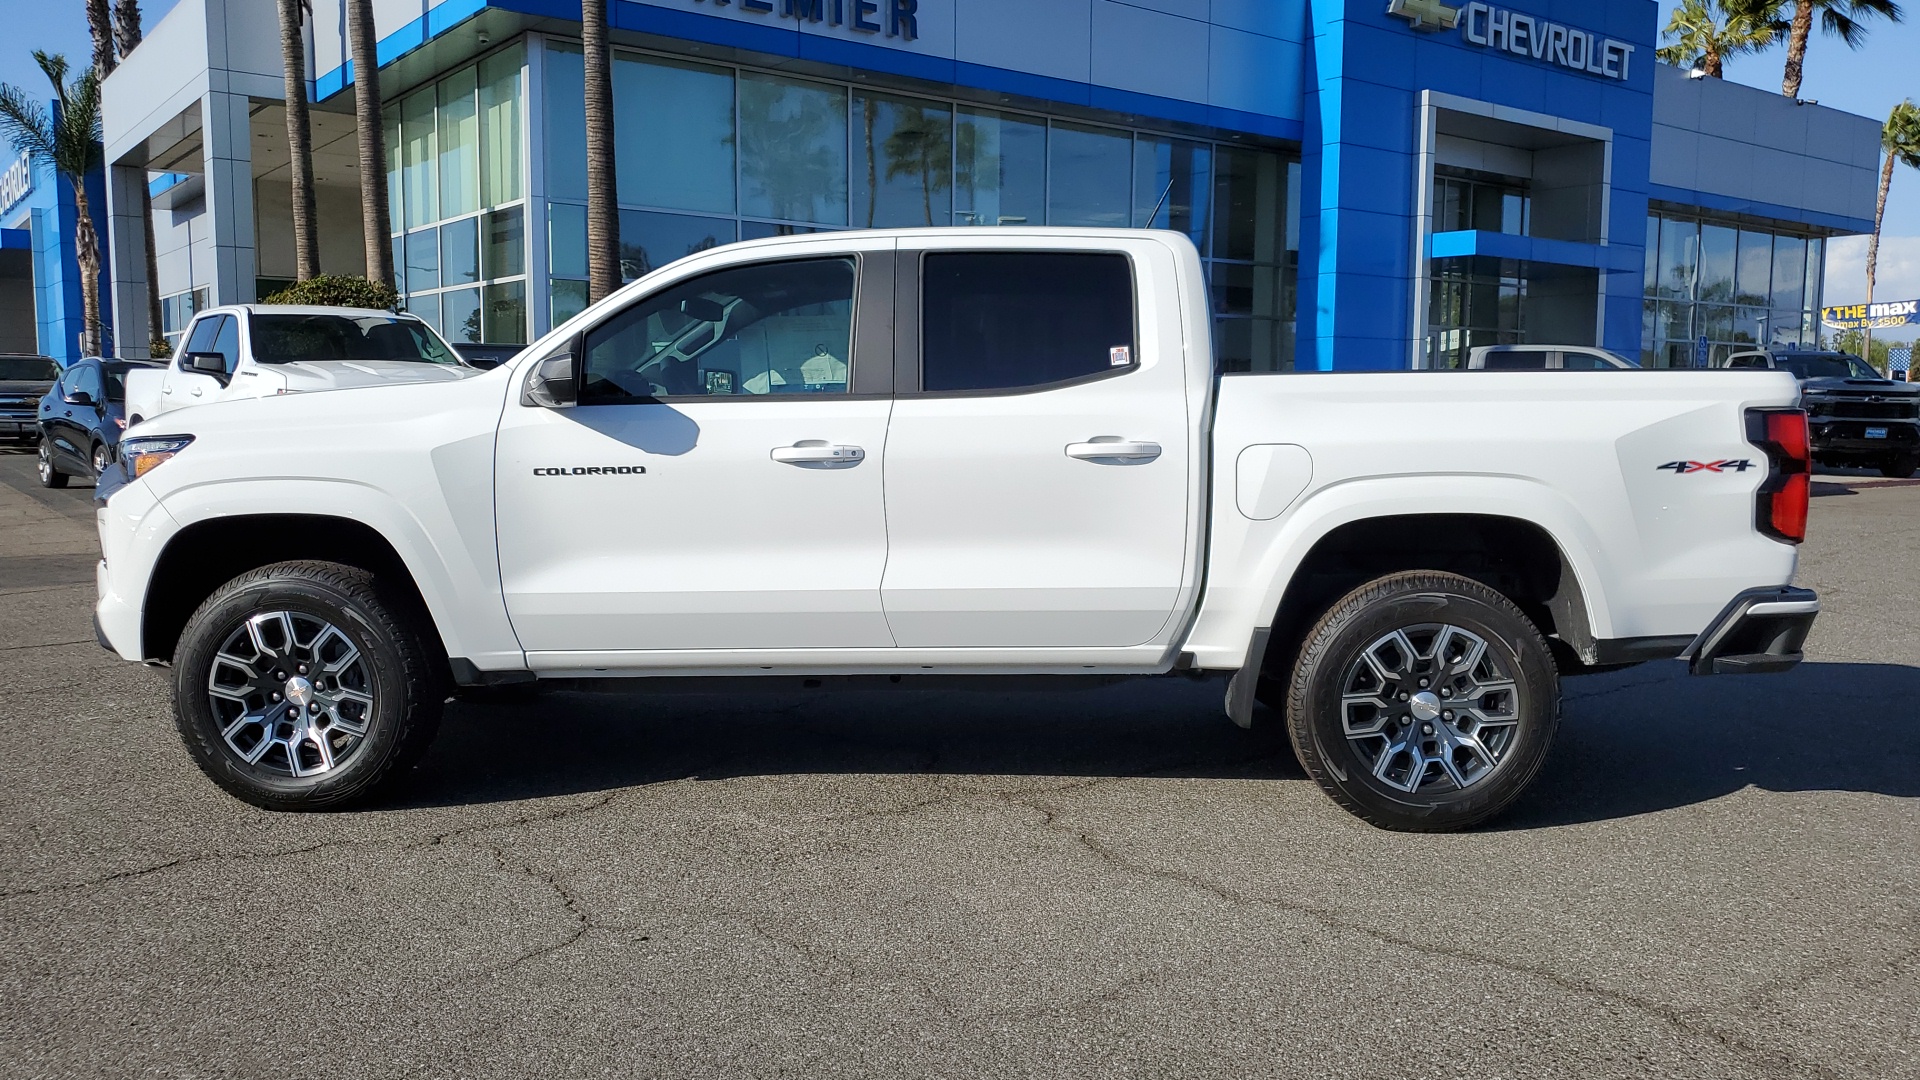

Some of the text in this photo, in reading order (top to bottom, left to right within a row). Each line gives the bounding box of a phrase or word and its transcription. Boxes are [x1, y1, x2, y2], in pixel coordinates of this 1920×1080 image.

[1467, 1, 1635, 80] CHEVROLET
[1833, 305, 1866, 319] THE
[1870, 301, 1916, 317] max
[533, 465, 647, 477] COLORADO
